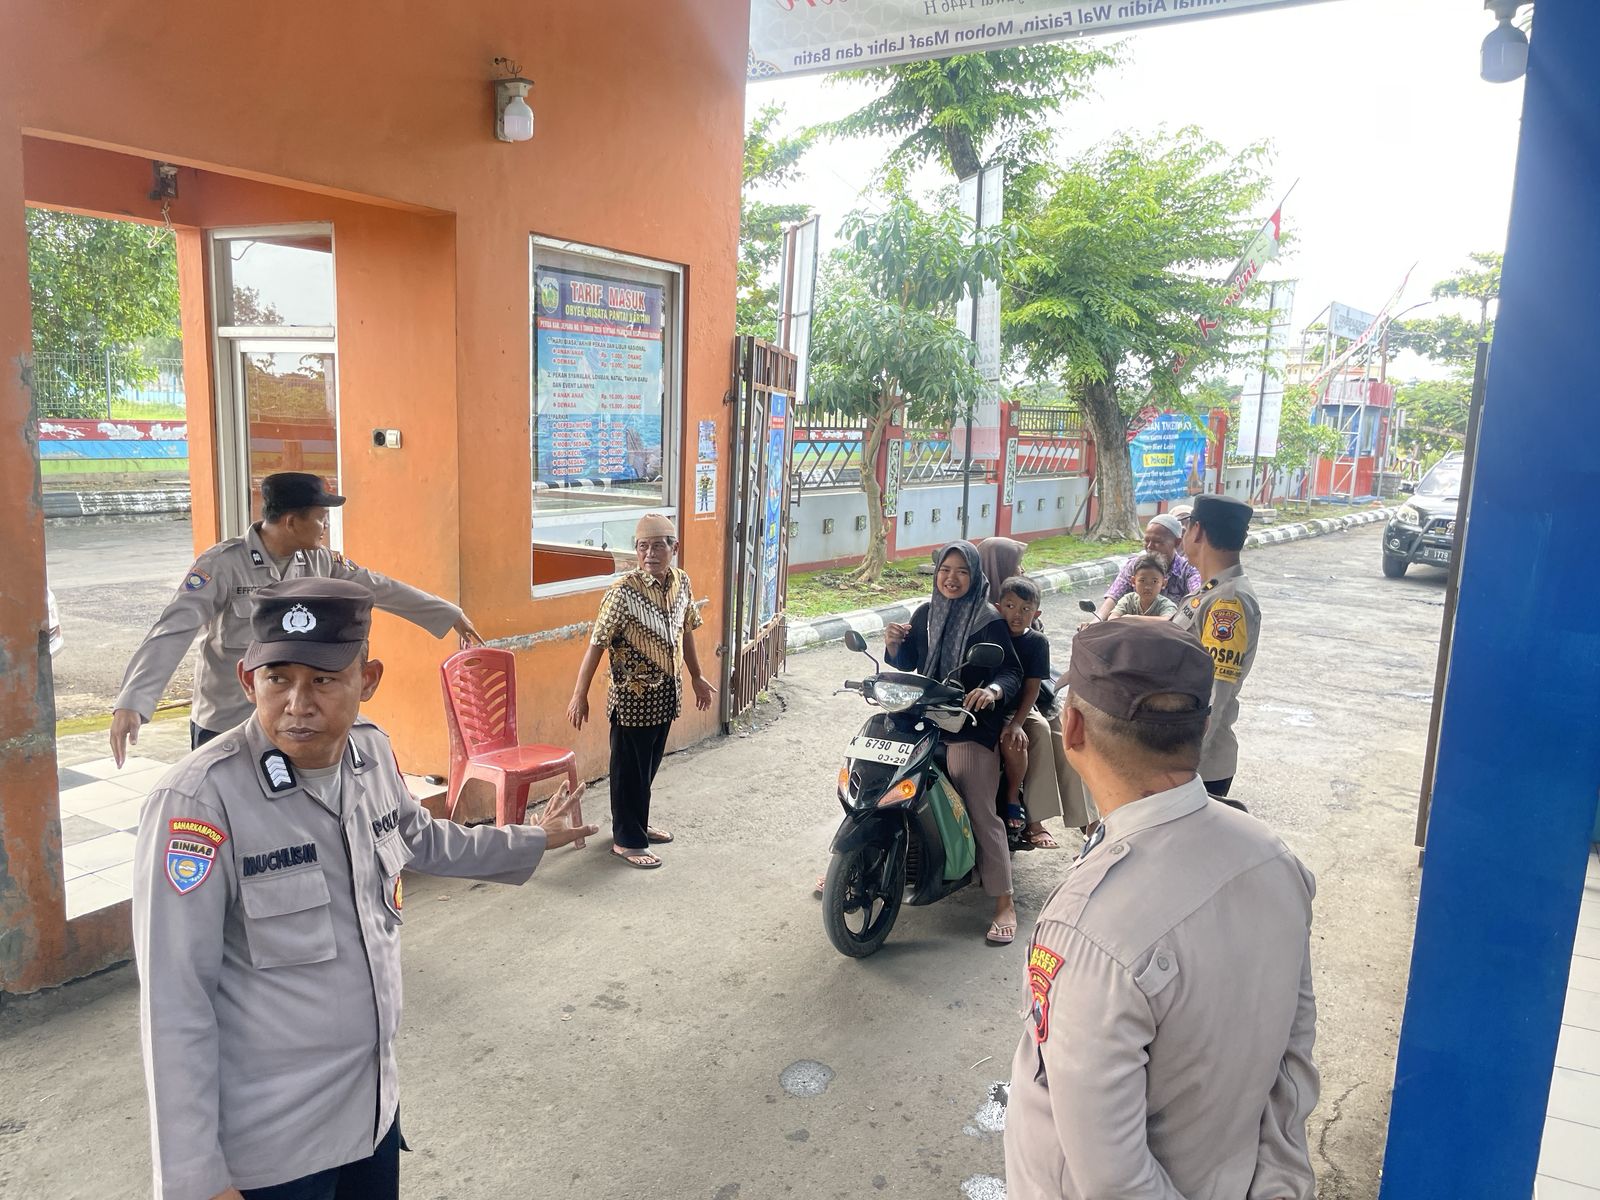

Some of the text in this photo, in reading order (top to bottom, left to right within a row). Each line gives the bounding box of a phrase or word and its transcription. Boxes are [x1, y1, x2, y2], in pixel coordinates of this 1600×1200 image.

[570, 281, 646, 311] TARIF MASUK
[850, 737, 858, 747] K
[865, 739, 892, 751] 6790
[898, 744, 910, 755] GL
[172, 841, 213, 856] BINMAS
